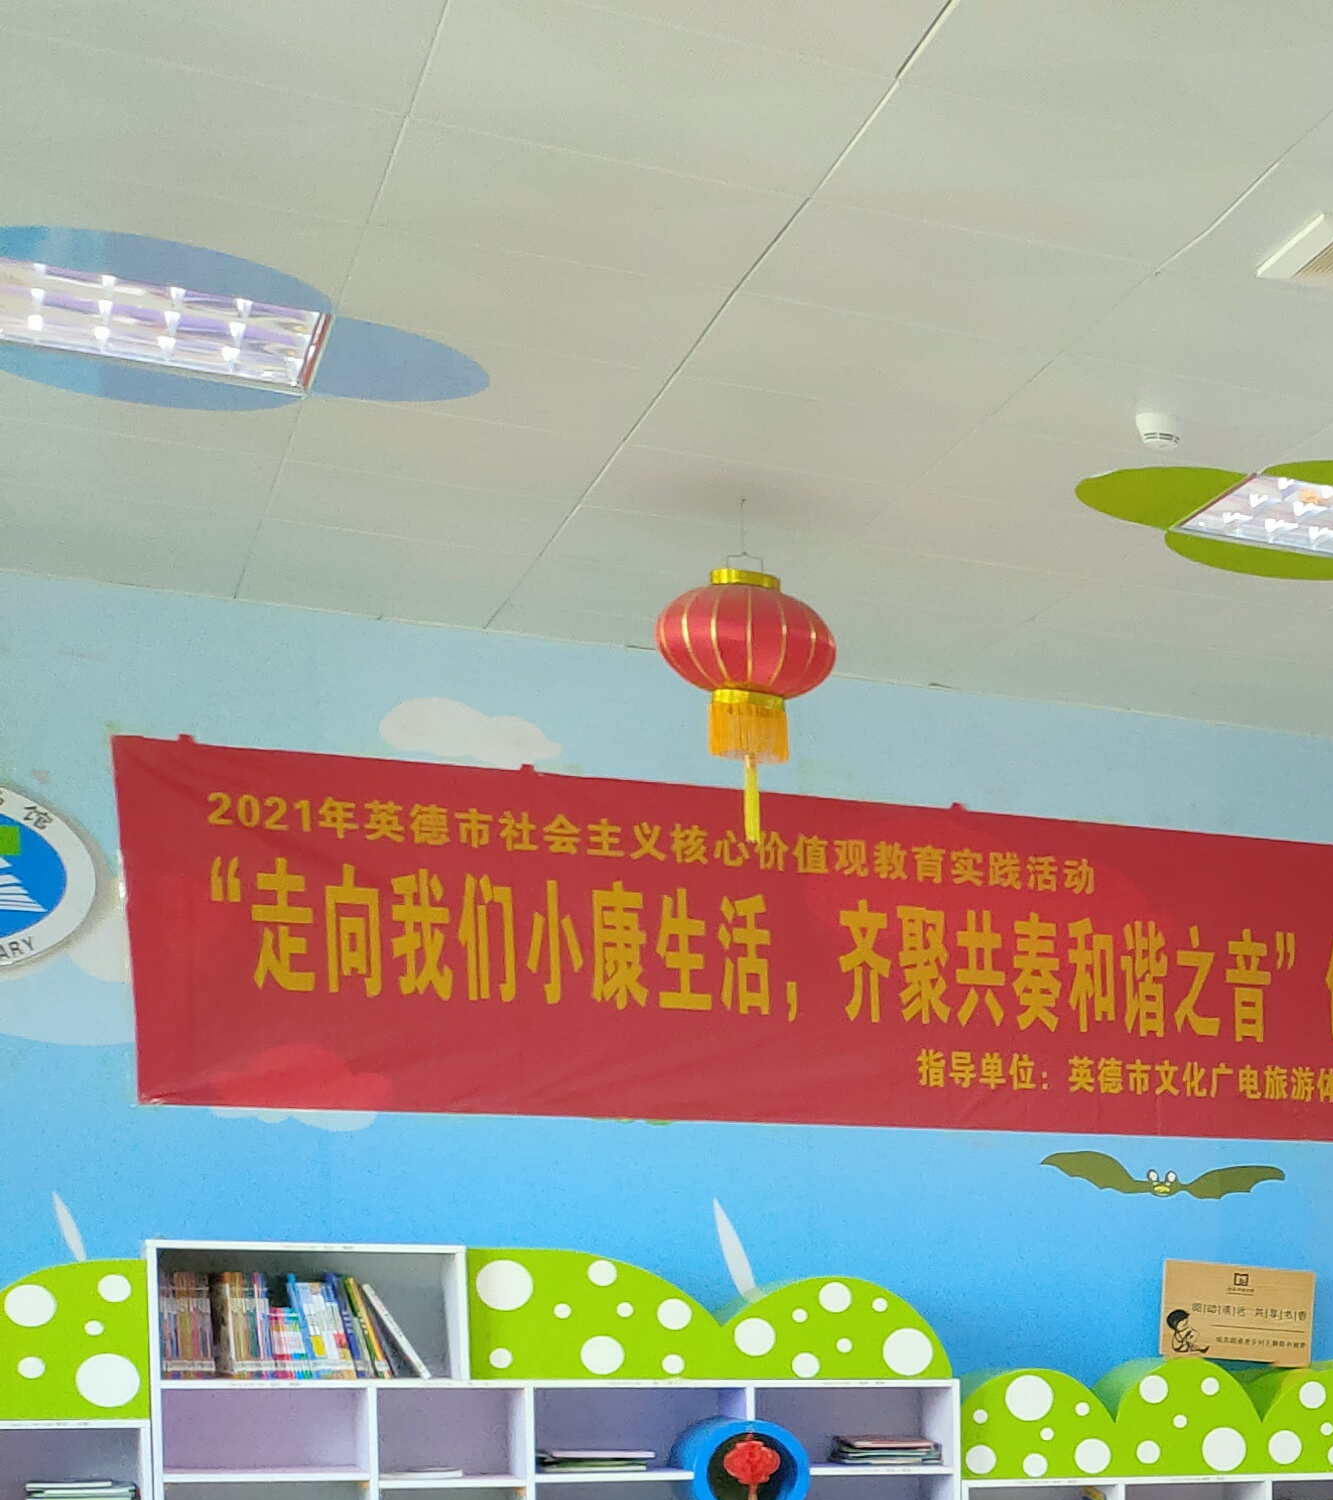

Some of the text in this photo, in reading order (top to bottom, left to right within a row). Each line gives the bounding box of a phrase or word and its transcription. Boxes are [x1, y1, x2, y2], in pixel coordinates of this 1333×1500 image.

[207, 792, 1095, 894] 2021年英德市社会主义核心价值观教育实践活动
